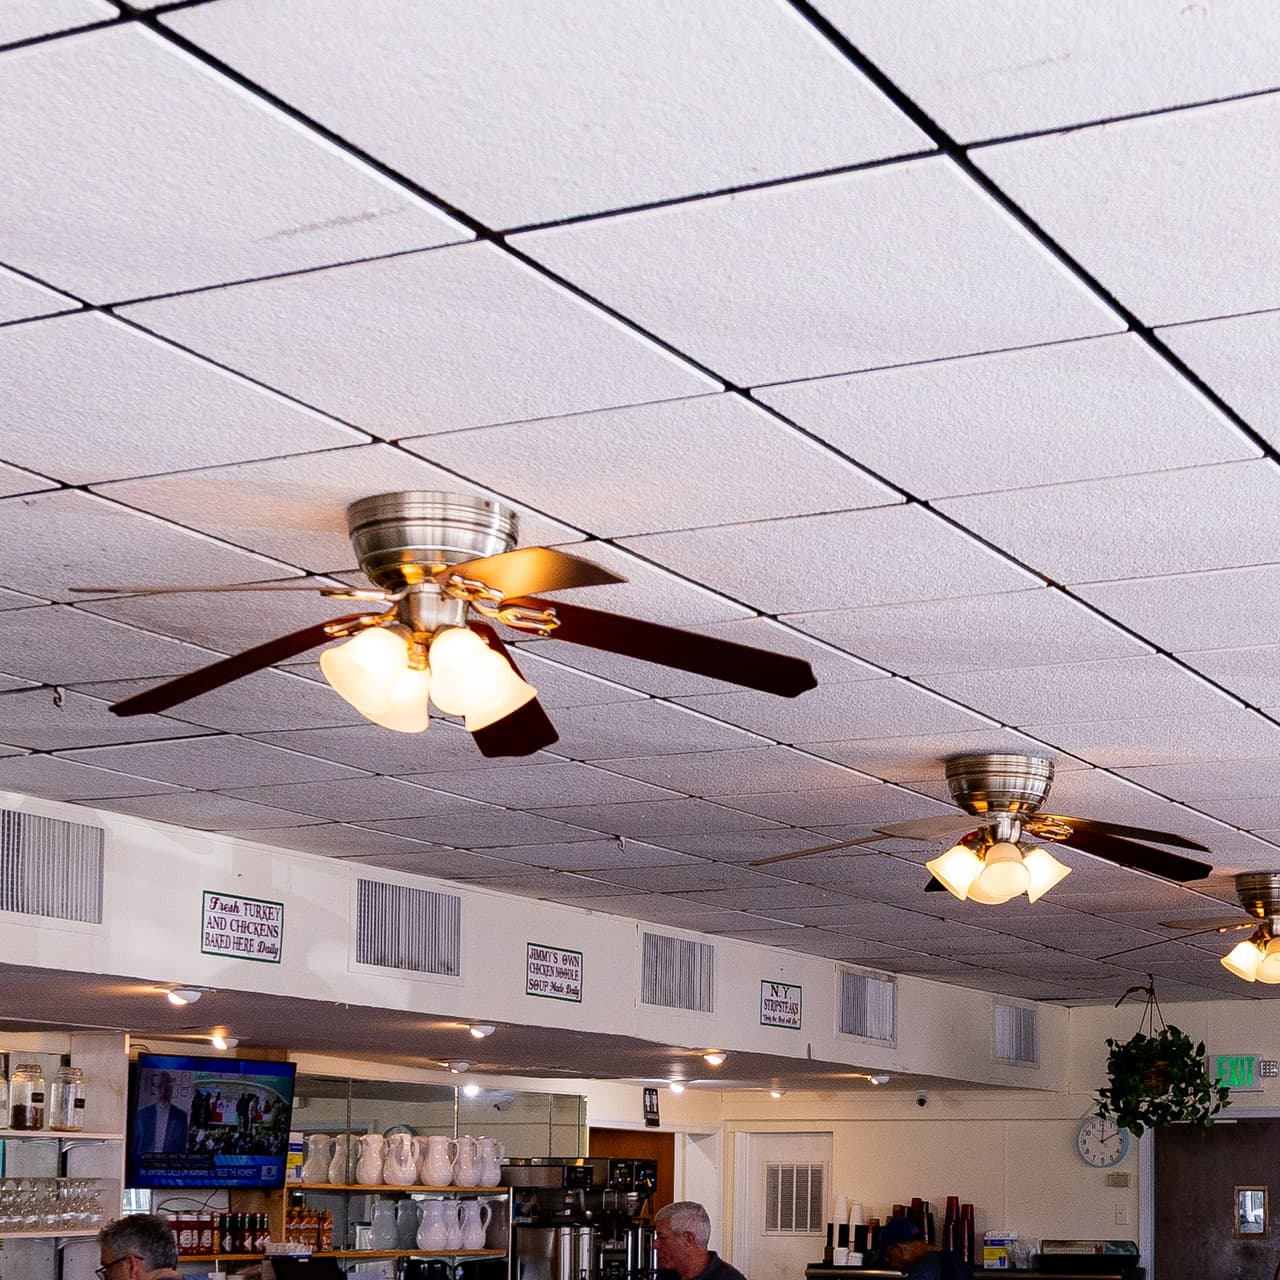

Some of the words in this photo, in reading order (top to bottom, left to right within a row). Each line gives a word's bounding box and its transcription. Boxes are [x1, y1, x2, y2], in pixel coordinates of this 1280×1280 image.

[209, 896, 240, 914] Fresh
[243, 902, 281, 921] TURKEY
[206, 915, 227, 931] AND
[230, 919, 279, 938] CHICKENS
[205, 932, 231, 950] BAKED
[232, 936, 255, 953] HERE
[257, 940, 279, 959] Daily
[529, 948, 558, 964] JIMMY'S
[562, 954, 580, 968] OWN
[529, 962, 554, 977] CHICKEN
[555, 967, 579, 981] NOODLE
[529, 978, 549, 992] SOUP
[1217, 1055, 1255, 1087] EXIT
